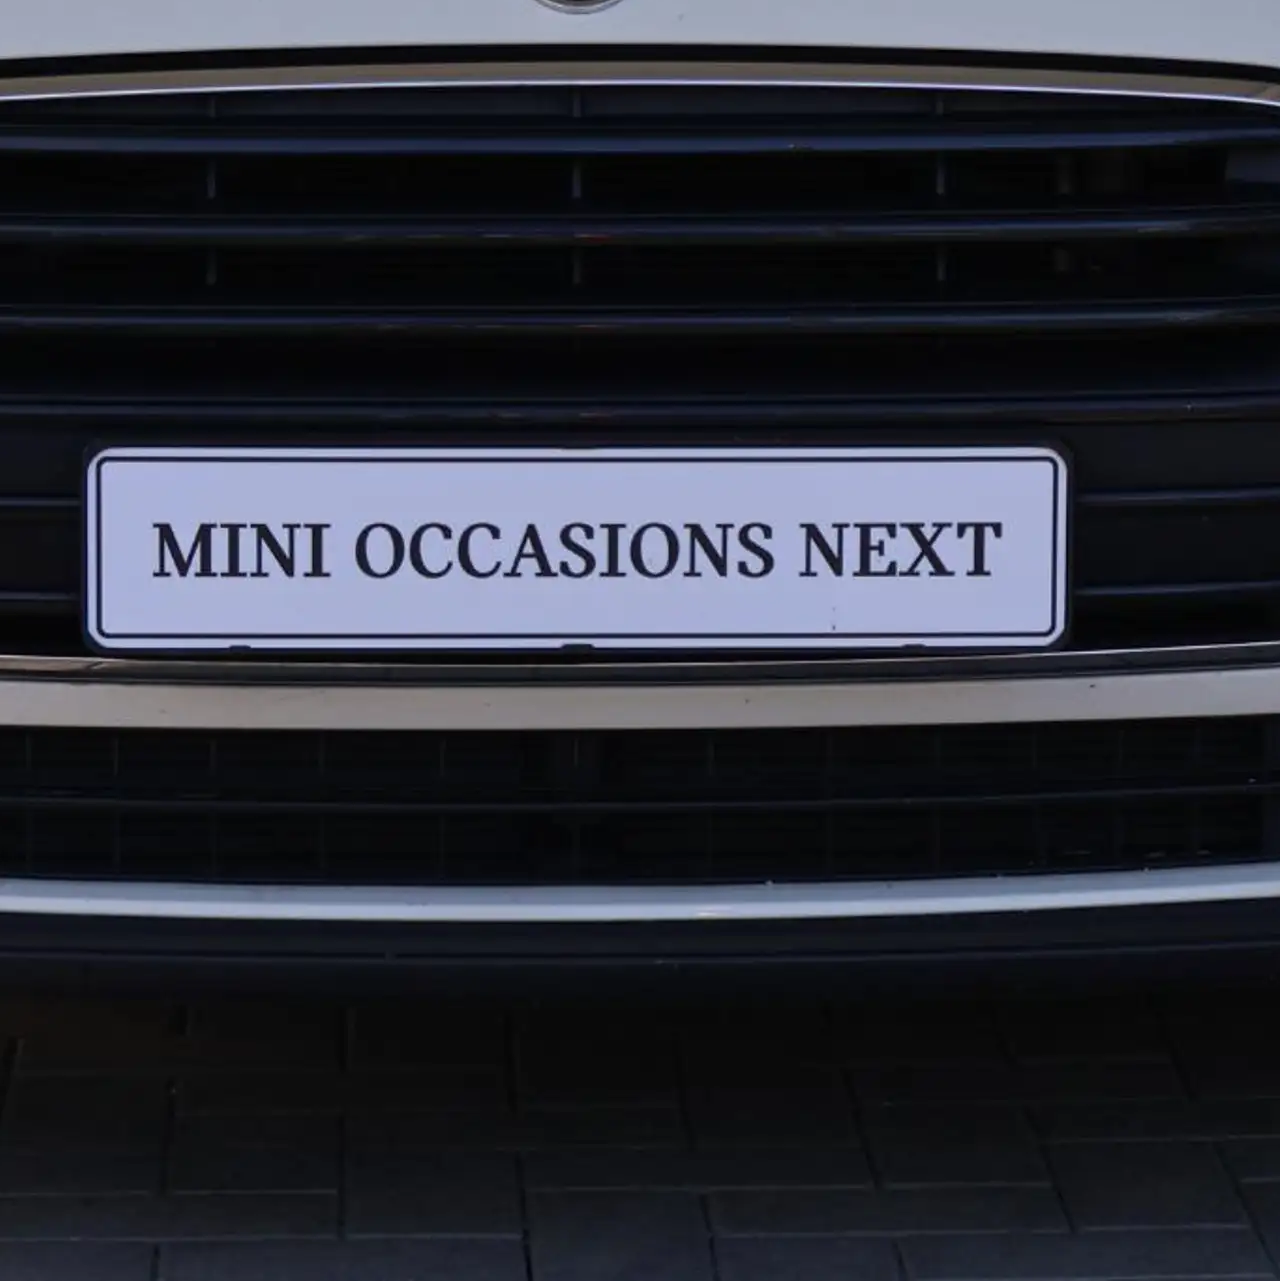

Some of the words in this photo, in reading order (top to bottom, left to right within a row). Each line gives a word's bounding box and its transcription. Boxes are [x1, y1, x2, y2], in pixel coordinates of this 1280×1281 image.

[152, 521, 332, 579] MINI
[355, 521, 776, 580] OCCASIONS
[798, 521, 1004, 579] NEXT
